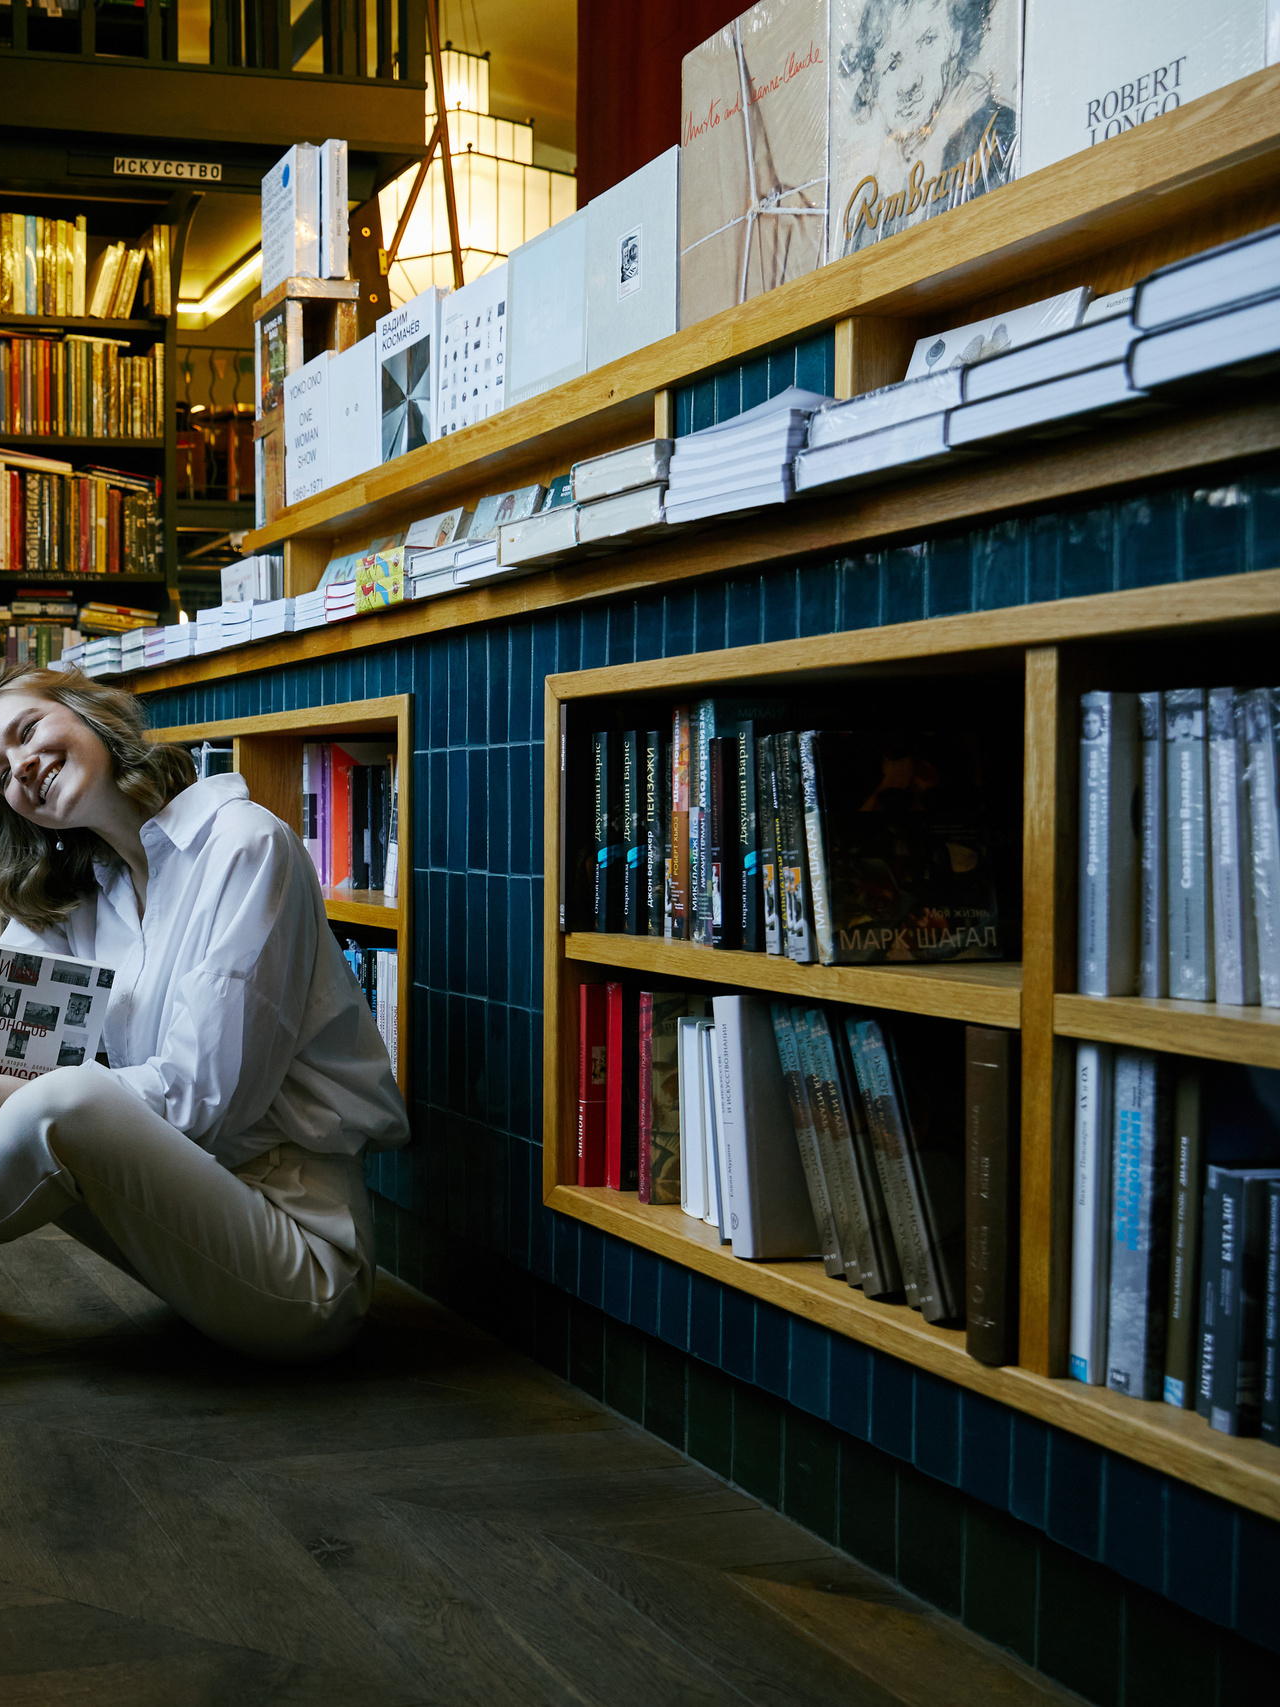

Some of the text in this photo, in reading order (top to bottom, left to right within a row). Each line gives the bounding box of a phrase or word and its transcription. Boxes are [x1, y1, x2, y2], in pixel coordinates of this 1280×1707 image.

[724, 91, 742, 120] and
[1086, 56, 1186, 129] ROBERT
[116, 159, 220, 178] ИСКУССТВО
[382, 311, 408, 336] ВАДИМ
[382, 320, 420, 352] КОСМАЧЁВ
[289, 371, 322, 400] YOKO ONO
[298, 408, 313, 426] ONE
[294, 426, 319, 450] WOMAN
[297, 450, 317, 469] SHOW
[698, 707, 708, 808] Модернизм
[738, 732, 748, 845] Джулиан Барнс
[594, 784, 602, 842] Джулиан
[623, 784, 631, 842] Джулиан
[805, 818, 826, 929] МАРК ШАГАЛ
[926, 908, 990, 919] Моя жизнь
[840, 926, 997, 950] МАРК ШАГАЛ
[722, 1024, 731, 1105] ИСКУССТВОЗНАНИИ
[1080, 1065, 1089, 1083] ОХ
[1080, 1094, 1089, 1112] АХ
[1078, 1120, 1088, 1168] Пивоваров
[1178, 1136, 1188, 1187] ДИАЛОГИ
[1078, 1173, 1088, 1206] Виктор
[1221, 1194, 1235, 1262] КАТАЛОГ
[1199, 1333, 1214, 1399] КАТАЛОГ
